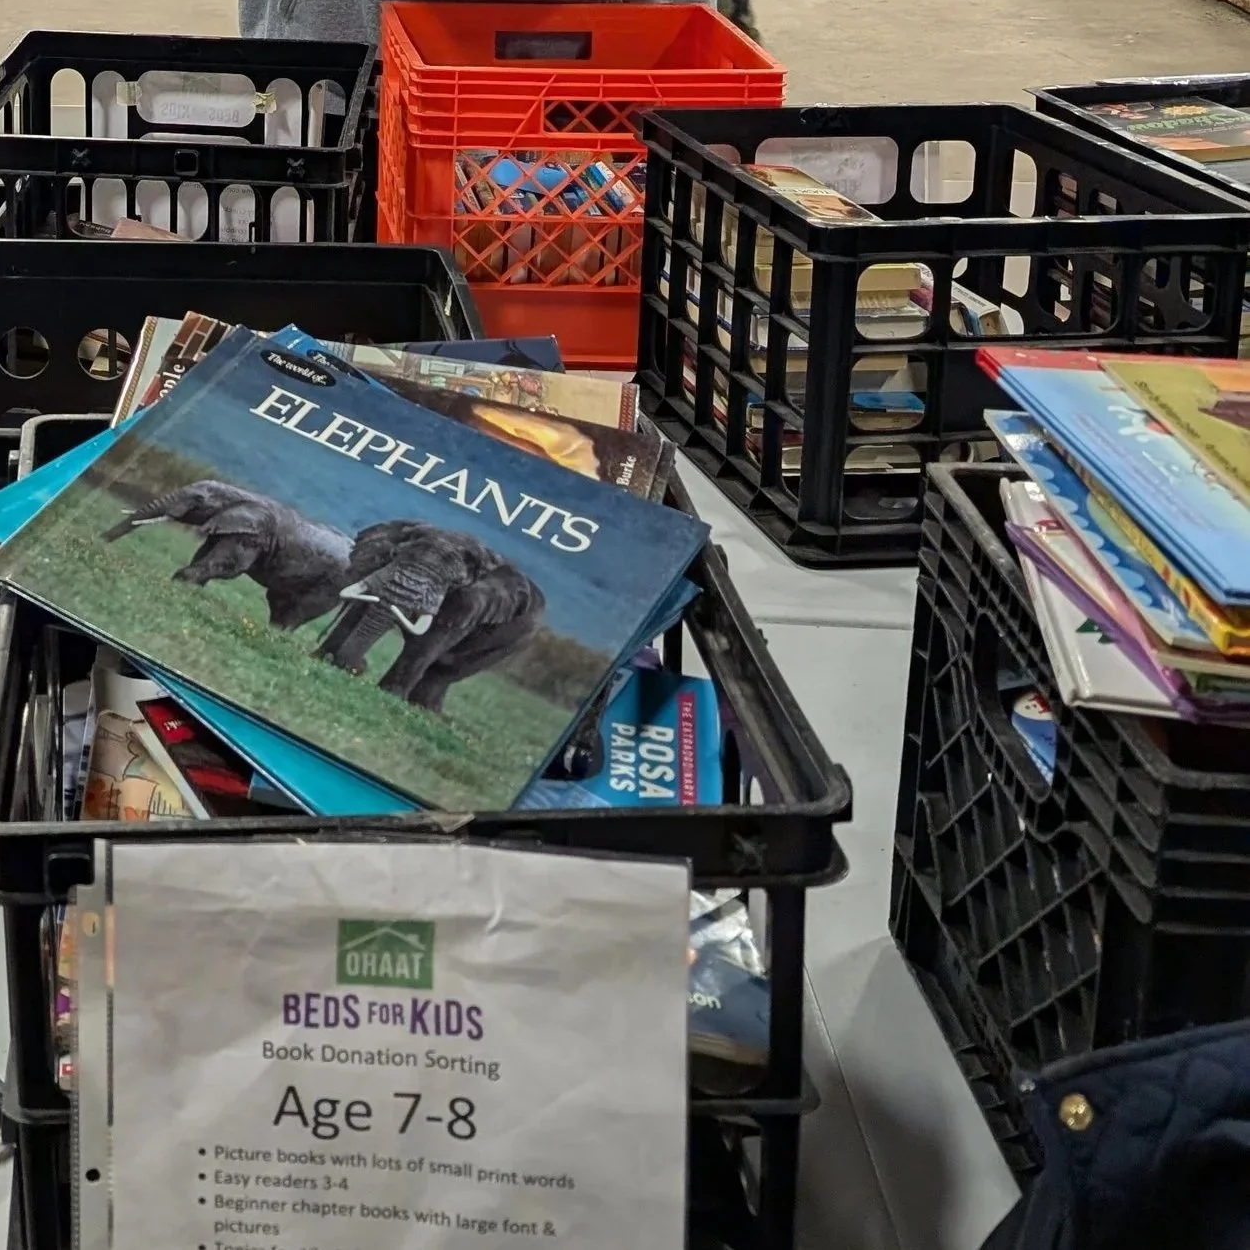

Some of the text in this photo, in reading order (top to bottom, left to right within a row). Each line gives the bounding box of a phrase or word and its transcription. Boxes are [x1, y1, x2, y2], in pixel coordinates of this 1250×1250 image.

[267, 352, 287, 368] The
[285, 360, 313, 379] world
[249, 384, 601, 554] ELEPHANTS
[615, 454, 638, 487] Burke
[609, 723, 636, 792] PARKS
[639, 724, 675, 798] ROSA
[345, 952, 426, 980] OHAAT
[283, 993, 484, 1041] BEDS FOR KIDS
[262, 1040, 501, 1082] Book Donation Sorting
[273, 1085, 477, 1141] Age 7-8
[214, 1146, 575, 1190] Picture books with lots of small print words
[214, 1169, 349, 1190] Easy readers 3-4
[214, 1194, 557, 1237] Beginner chapter books with large font &
[214, 1218, 280, 1236] pictures
